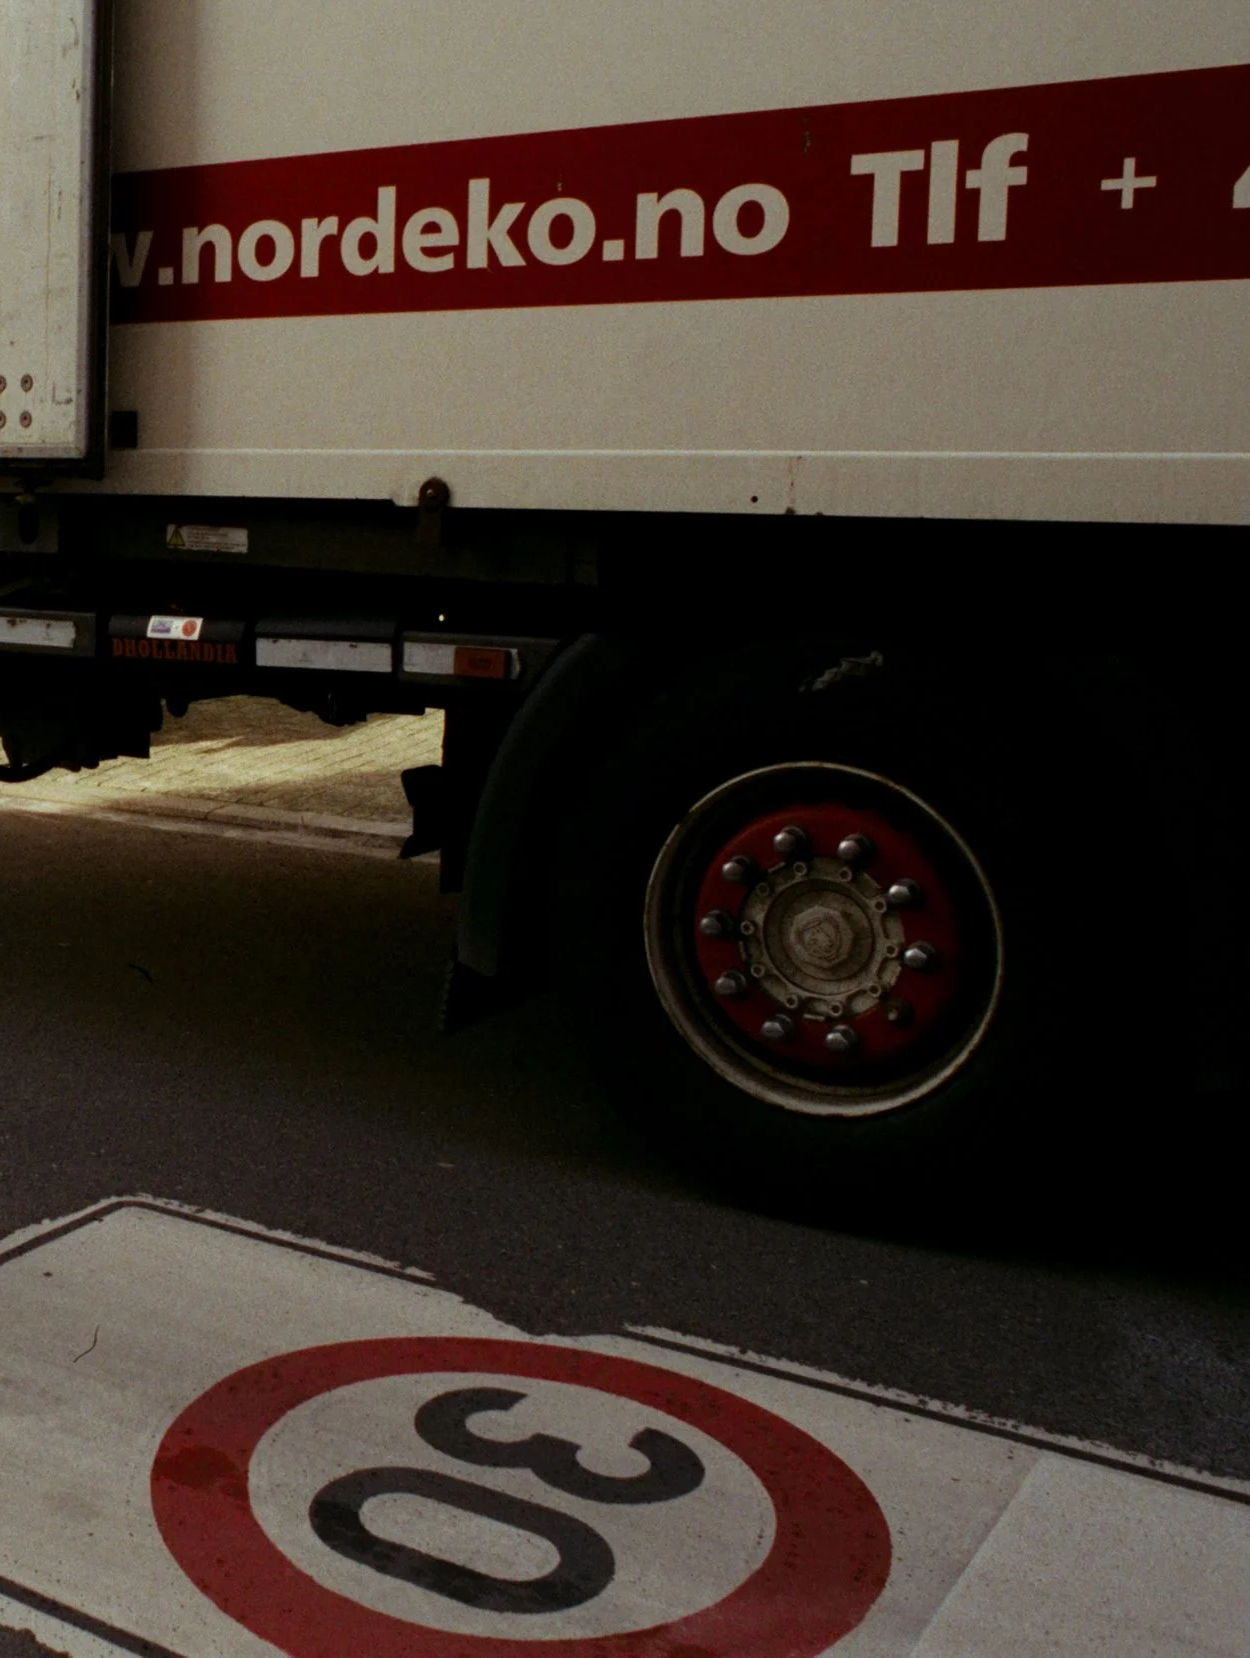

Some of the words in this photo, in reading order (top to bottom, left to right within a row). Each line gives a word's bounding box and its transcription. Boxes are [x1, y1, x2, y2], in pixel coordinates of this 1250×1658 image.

[851, 132, 1030, 249] Tlf
[111, 637, 239, 664] DHOLLANDIA
[308, 1386, 706, 1614] 30
